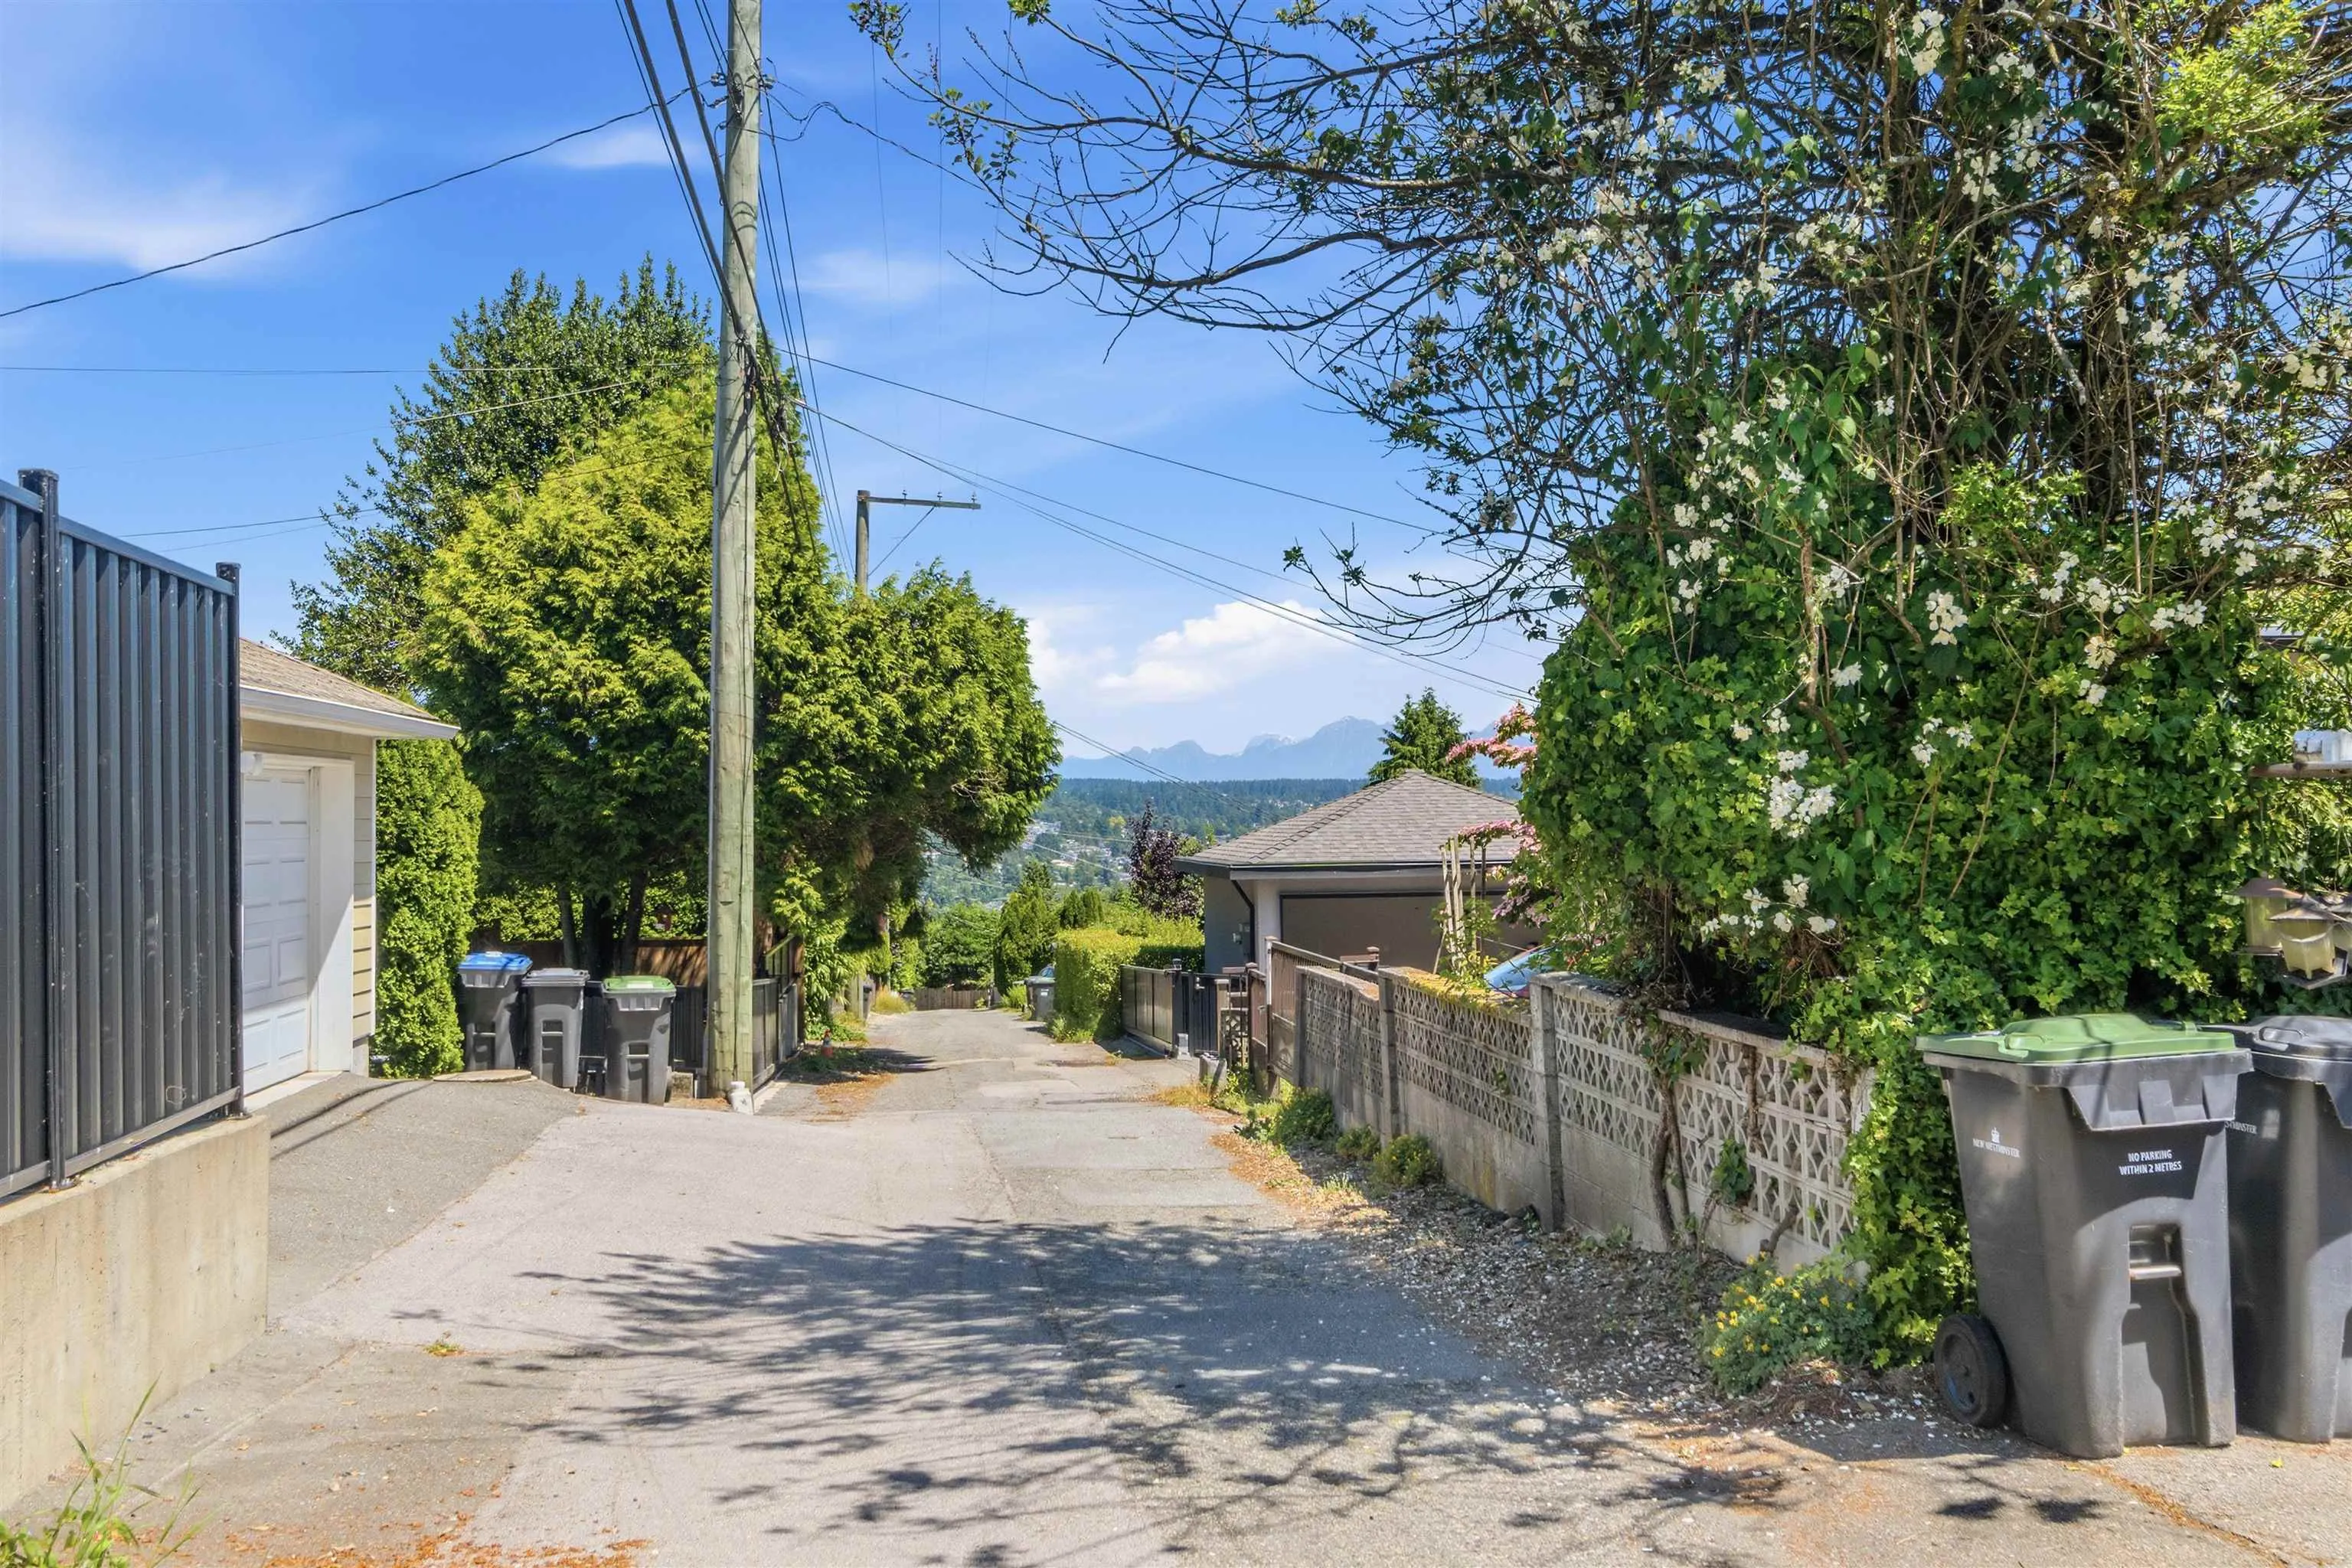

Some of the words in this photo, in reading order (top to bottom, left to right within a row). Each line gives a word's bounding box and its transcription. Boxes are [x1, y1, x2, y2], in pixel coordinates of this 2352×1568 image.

[2128, 1152, 2140, 1162] NO
[2140, 1149, 2173, 1161] PARKING
[2118, 1164, 2148, 1175] WITHIN
[2148, 1164, 2154, 1173] 2
[2154, 1161, 2182, 1172] METRES
